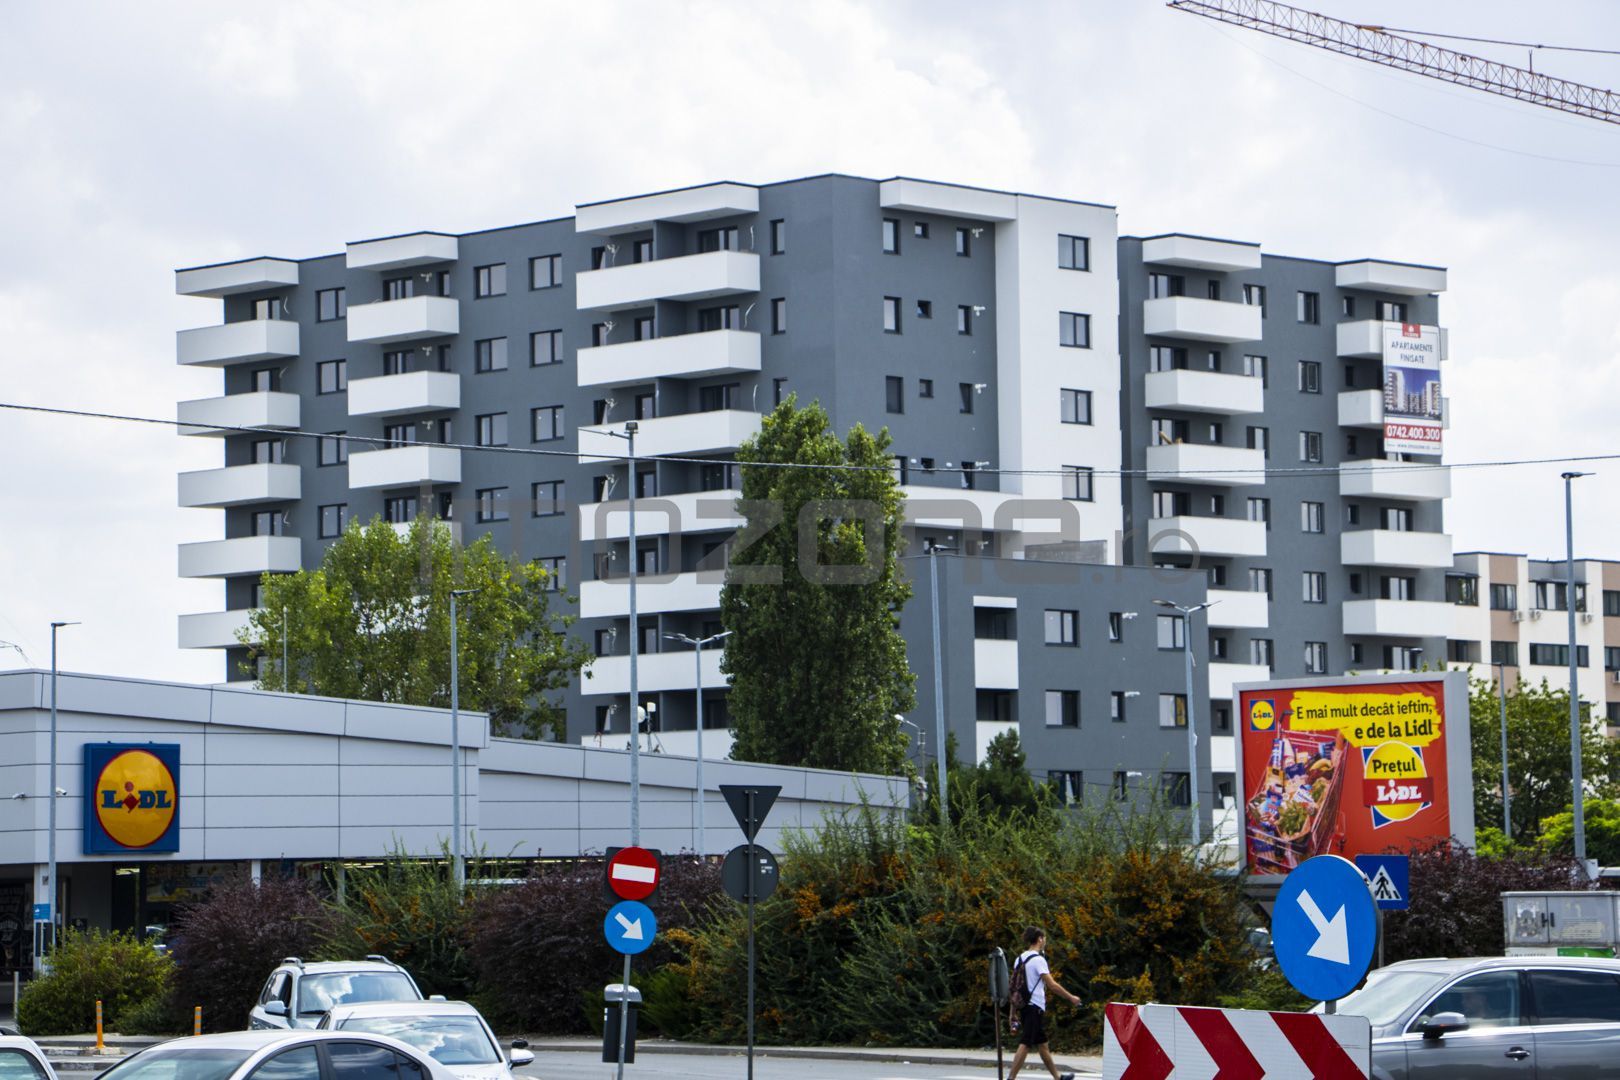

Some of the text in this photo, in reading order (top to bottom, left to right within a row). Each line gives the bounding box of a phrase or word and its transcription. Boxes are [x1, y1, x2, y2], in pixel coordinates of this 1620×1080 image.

[1391, 341, 1433, 353] APARTAMENTE
[1400, 353, 1425, 364] FINISATE
[1386, 424, 1440, 440] 0742.400.300
[1297, 699, 1433, 719] E mai mult decât ieftin,
[1355, 719, 1433, 739] e de la Lidl
[1373, 757, 1417, 776] Prețul
